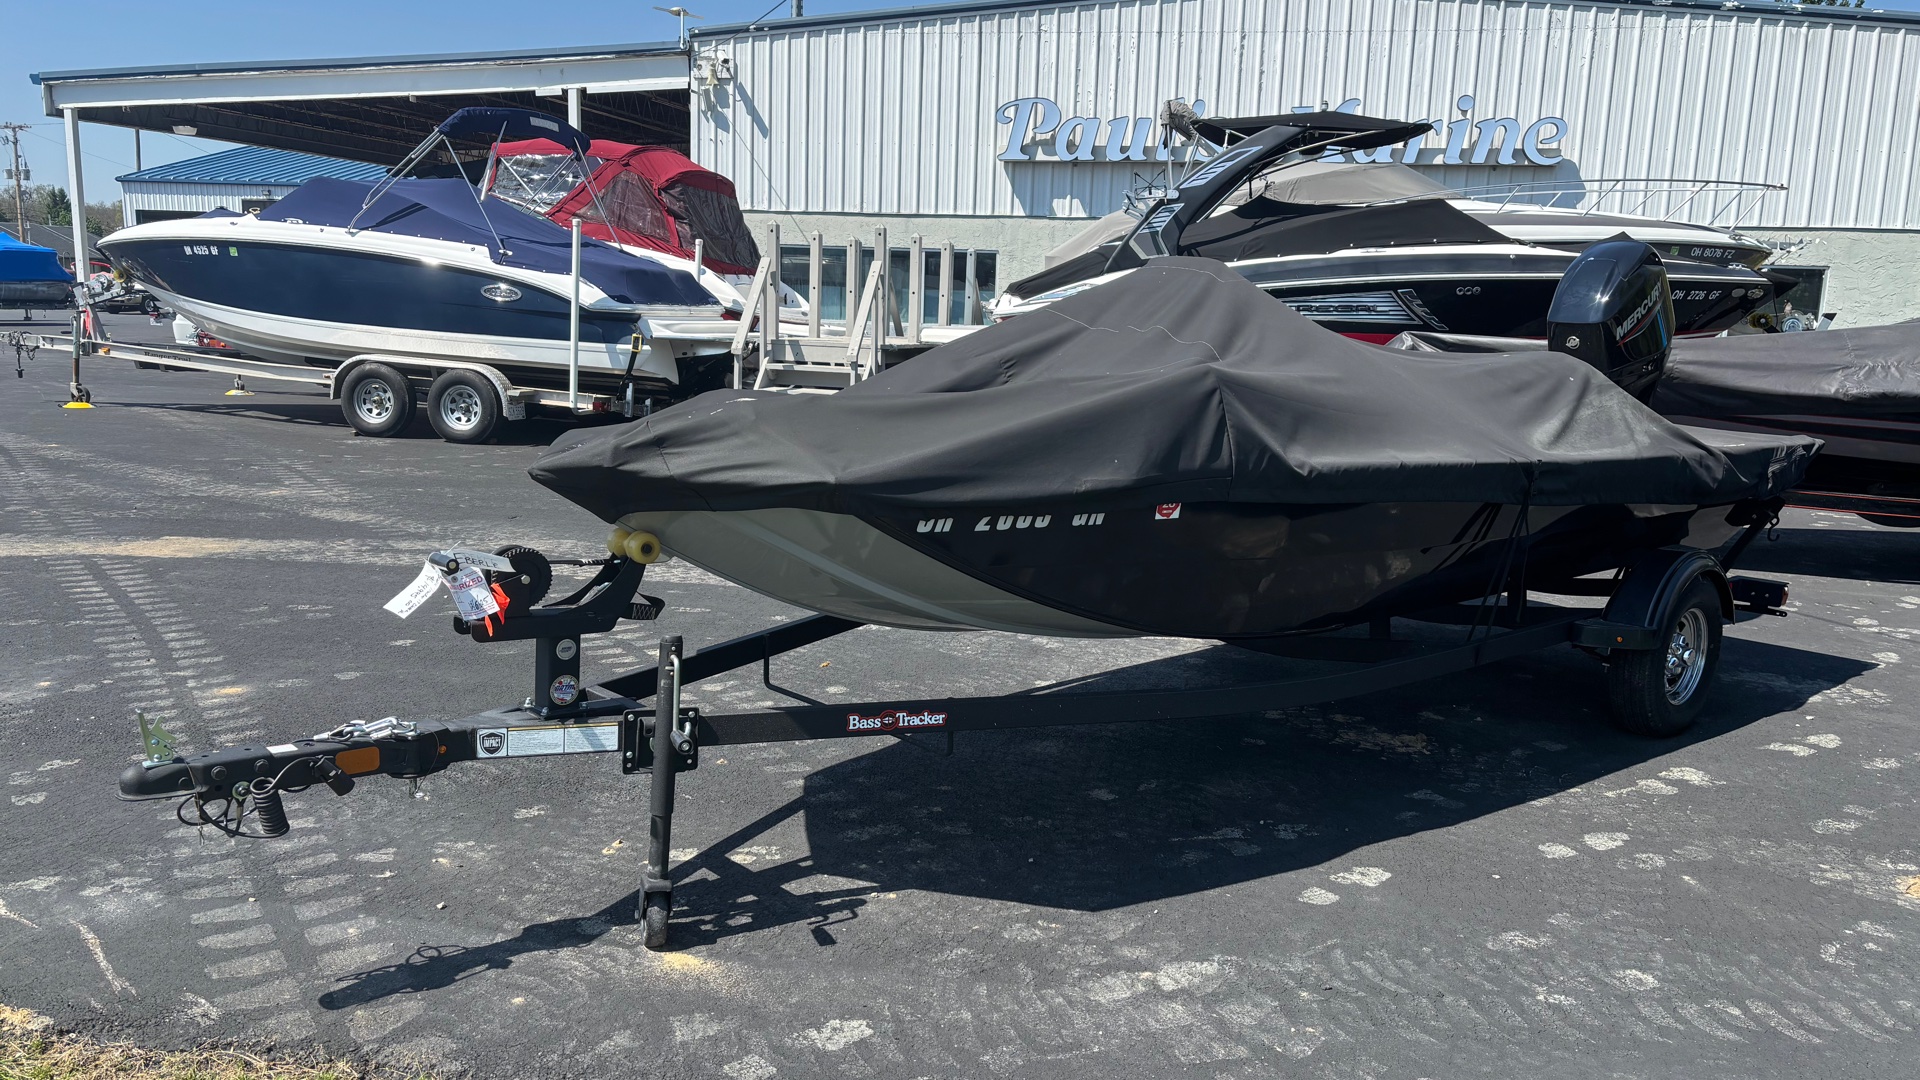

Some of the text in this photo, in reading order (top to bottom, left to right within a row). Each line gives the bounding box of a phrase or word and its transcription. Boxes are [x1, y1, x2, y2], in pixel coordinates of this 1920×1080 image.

[1691, 247, 1703, 257] OH
[1723, 249, 1736, 259] FZ
[1671, 290, 1722, 300] OH 2726 GF
[1616, 277, 1662, 341] MERCURY
[848, 712, 946, 730] Bass Tracker
